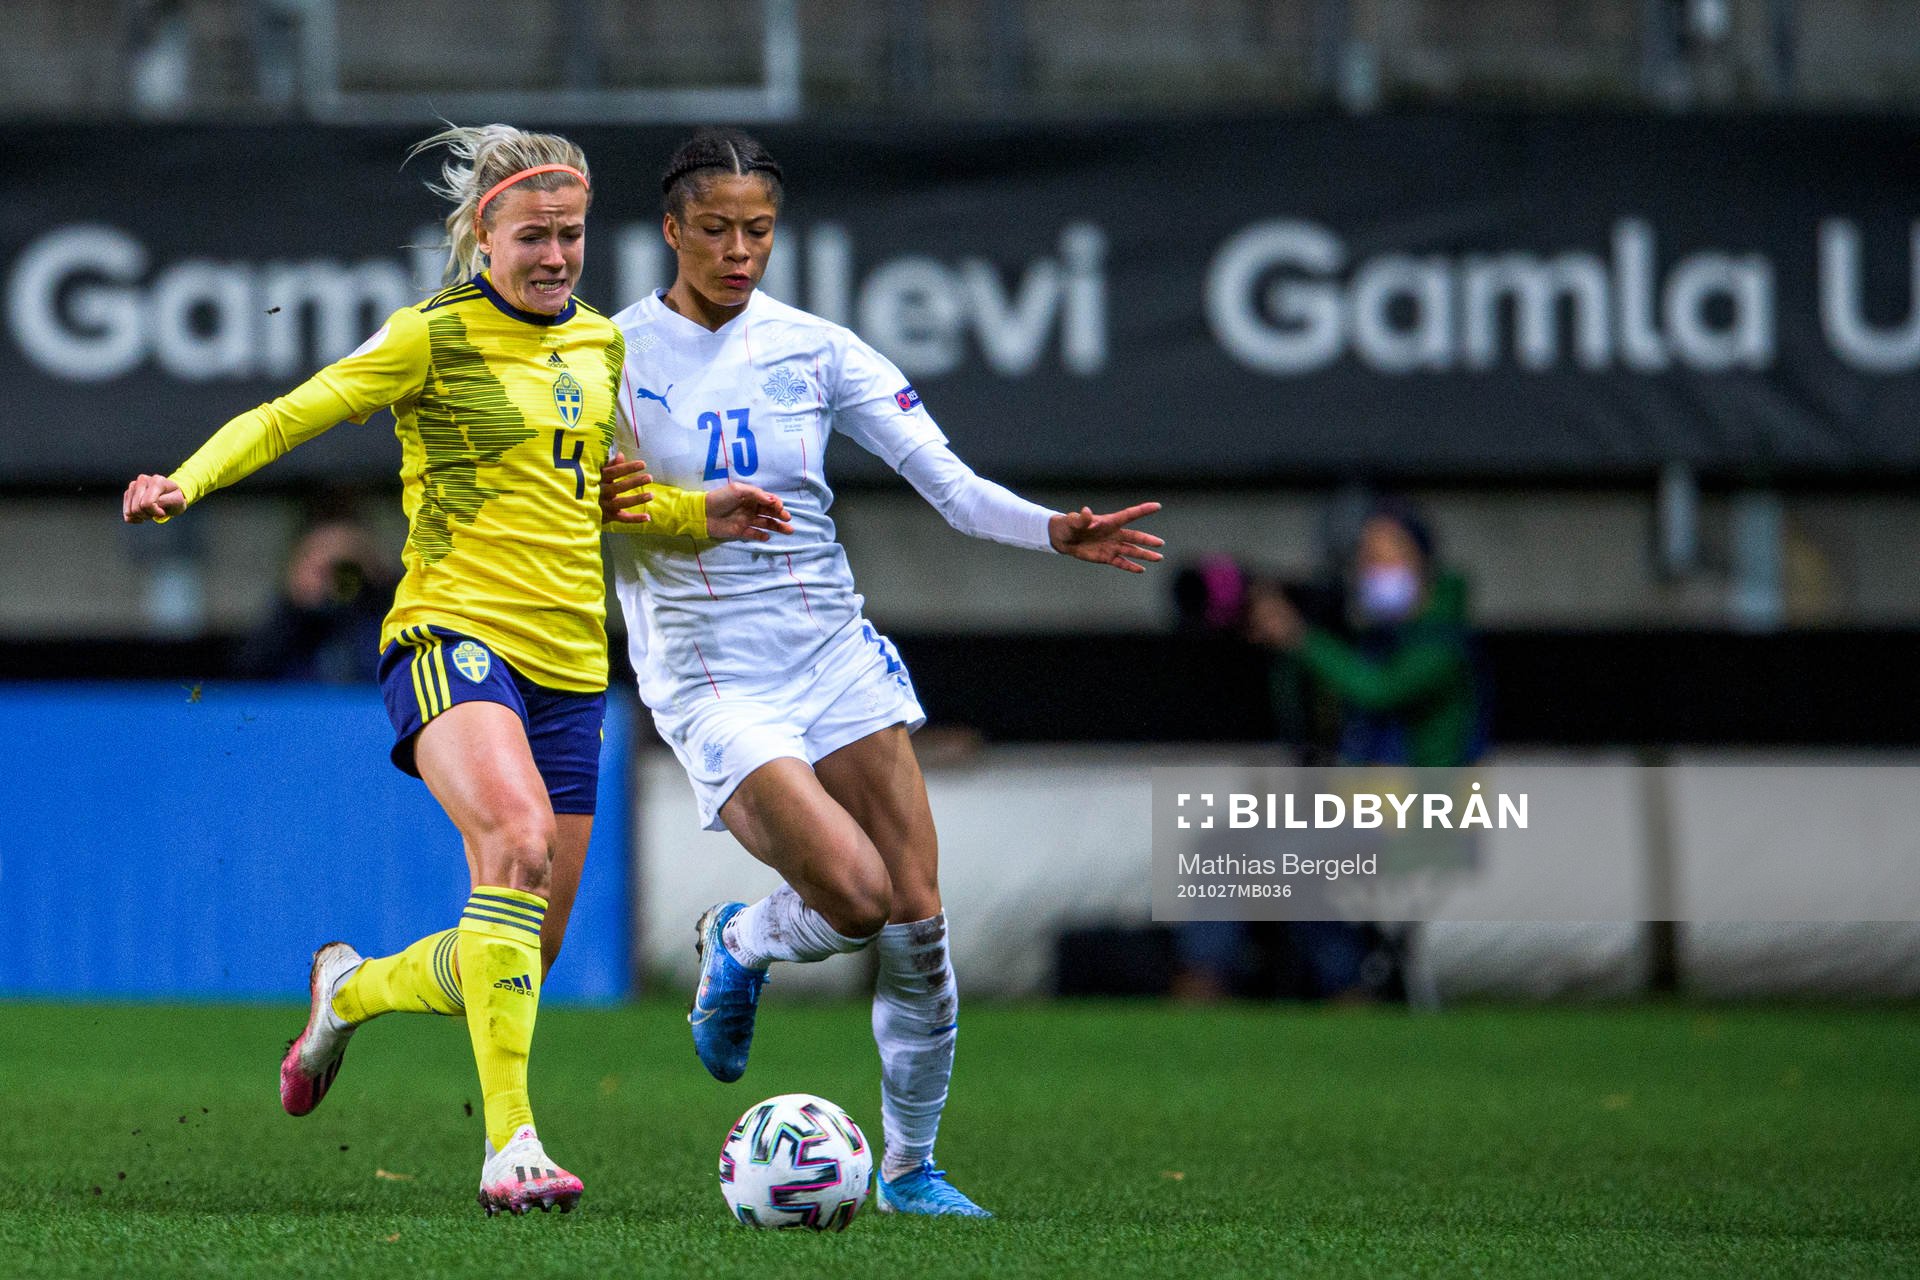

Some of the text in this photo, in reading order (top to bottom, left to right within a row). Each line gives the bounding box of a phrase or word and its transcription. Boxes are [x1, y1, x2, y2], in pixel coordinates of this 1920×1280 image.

[8, 222, 452, 380] Gam
[616, 222, 1108, 377] levi
[1206, 218, 1776, 376] Gamla
[553, 428, 586, 500] 4
[697, 408, 759, 482] 23
